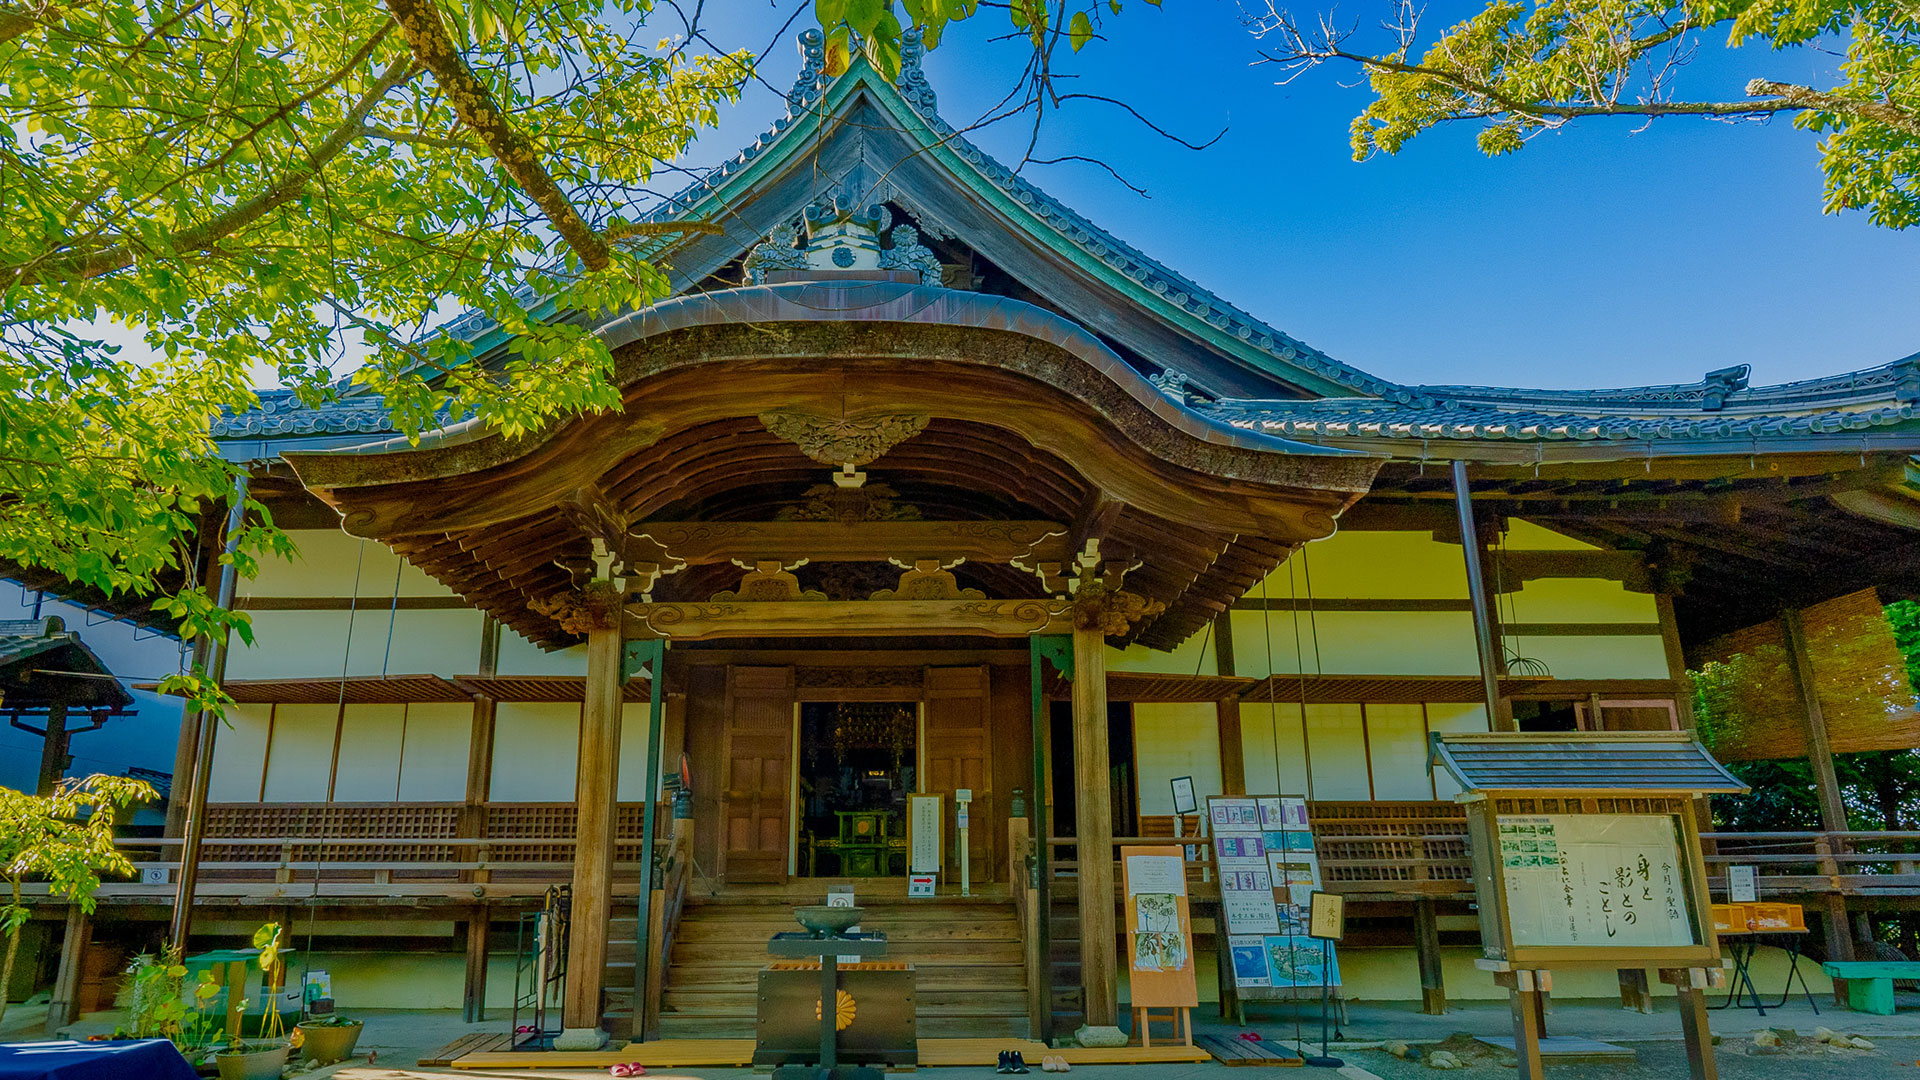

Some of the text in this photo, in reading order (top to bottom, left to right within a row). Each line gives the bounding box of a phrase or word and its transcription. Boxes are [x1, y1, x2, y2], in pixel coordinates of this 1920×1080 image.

[1614, 866, 1637, 925] 影との
[1636, 853, 1653, 901] 身と
[1599, 881, 1616, 938] ごとし
